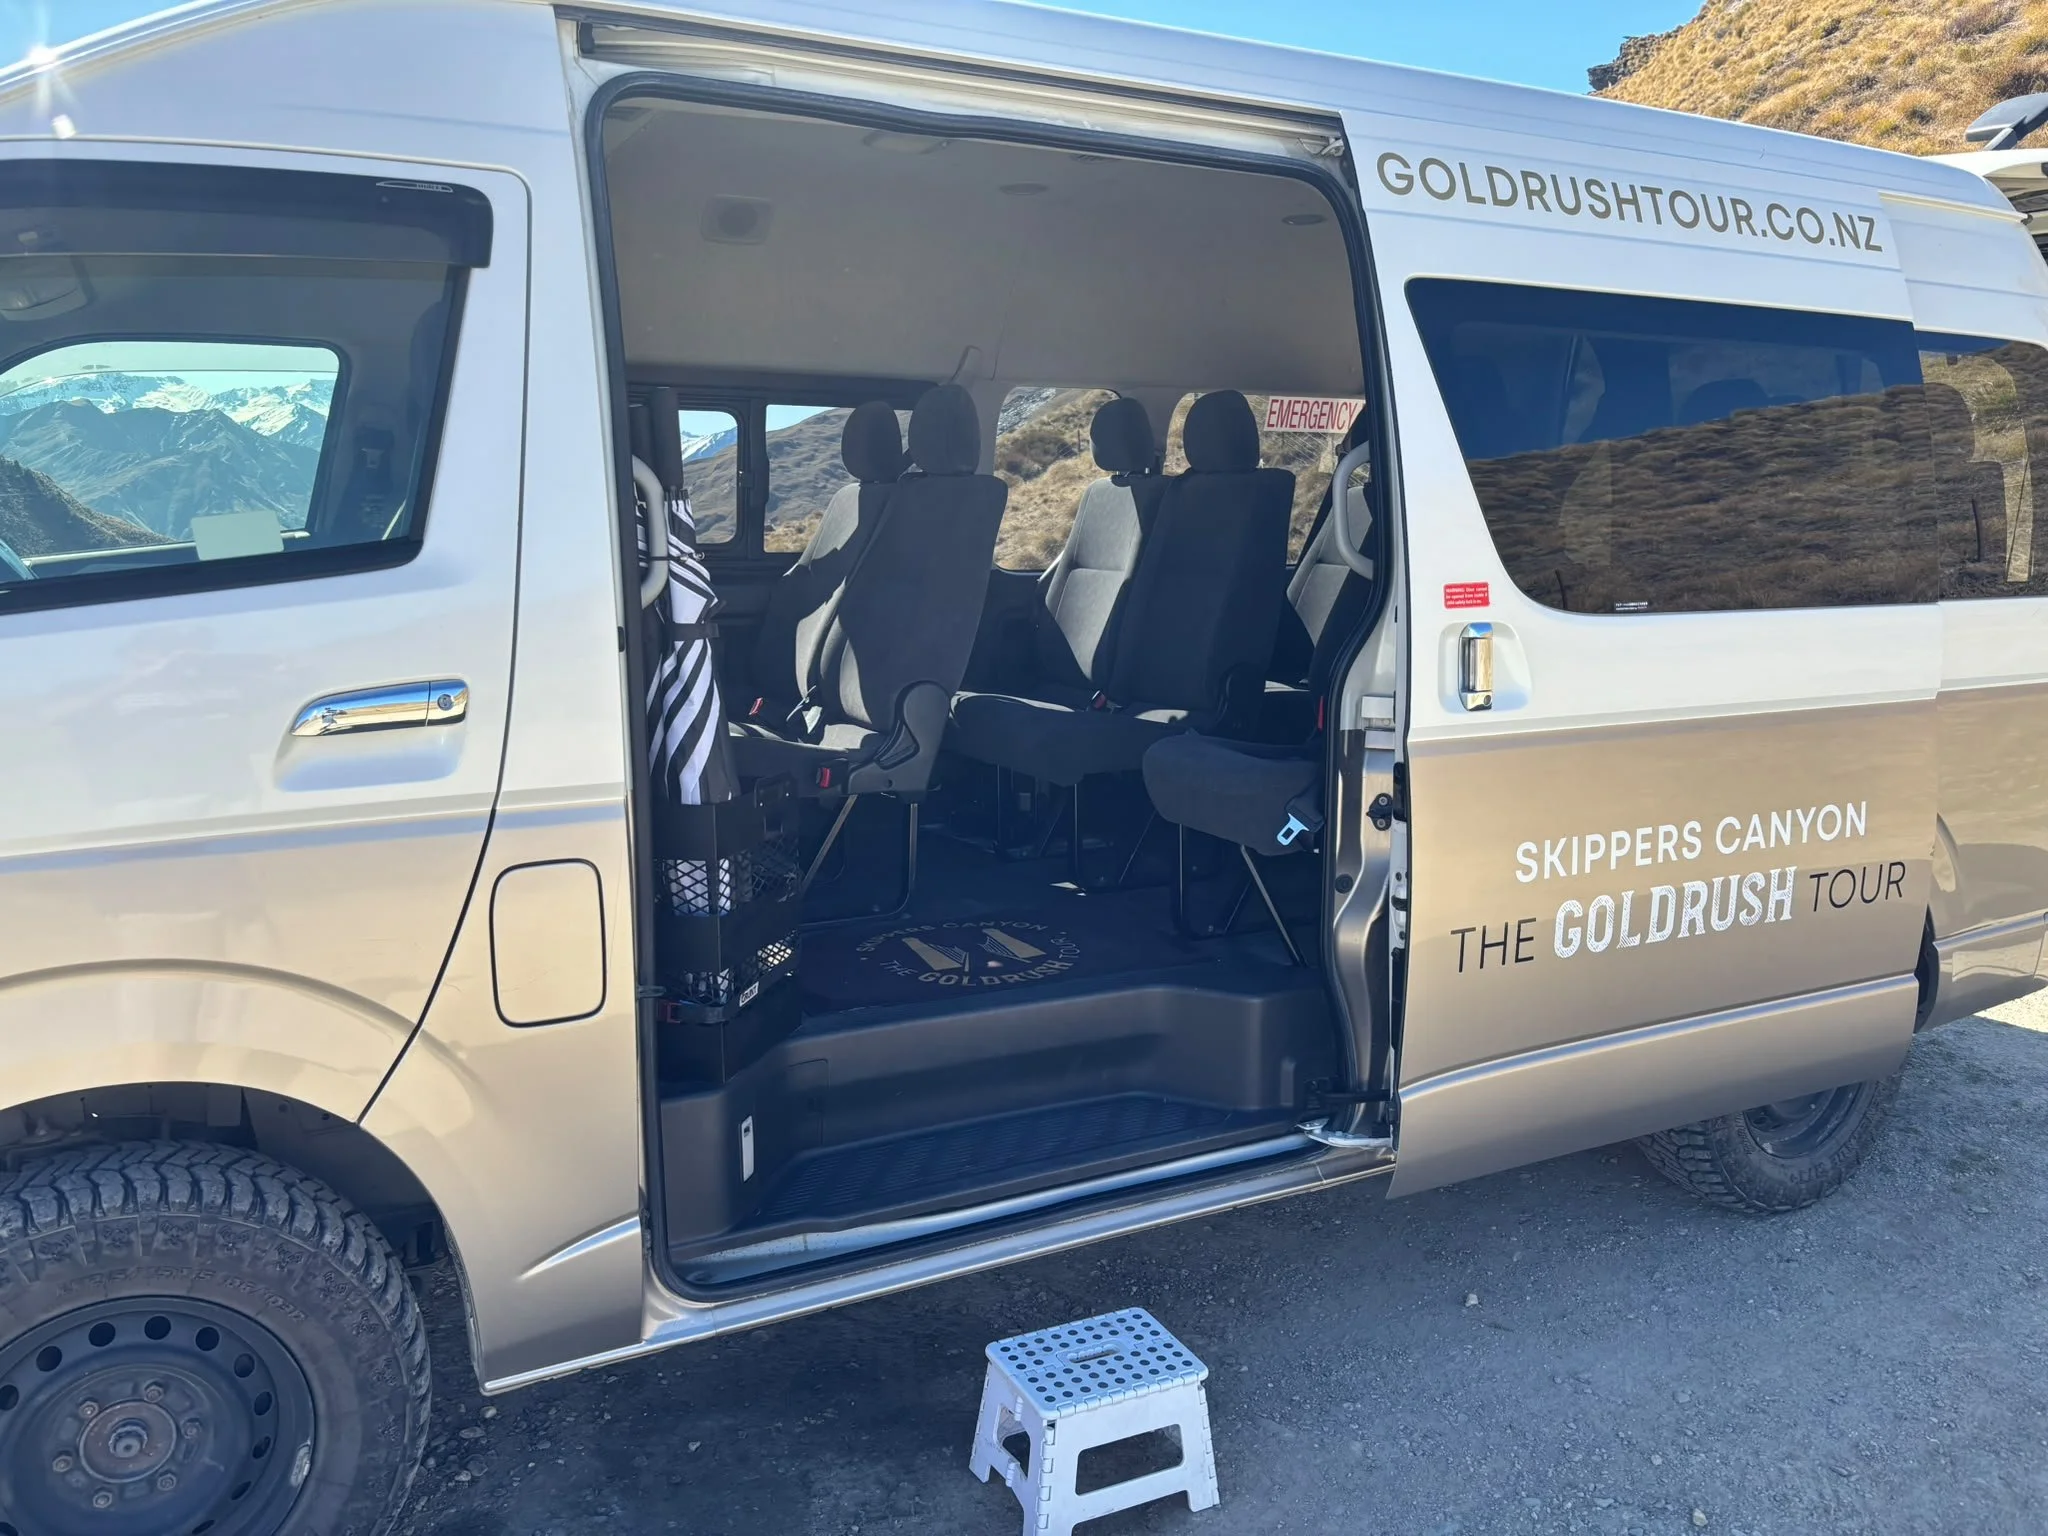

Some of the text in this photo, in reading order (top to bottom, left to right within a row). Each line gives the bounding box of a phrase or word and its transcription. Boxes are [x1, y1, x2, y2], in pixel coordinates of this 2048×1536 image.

[1377, 152, 1883, 252] GOLDRUSHTOUR.CO.NZ
[1267, 399, 1358, 430] EMERGENCY
[1516, 801, 1867, 882] SKIPPERS CANYON
[943, 921, 1048, 931] CANYON
[1451, 861, 1906, 973] THE GOLDRUSH TOUR
[880, 960, 919, 976] THE
[918, 960, 1074, 986] GOLDRUSH
